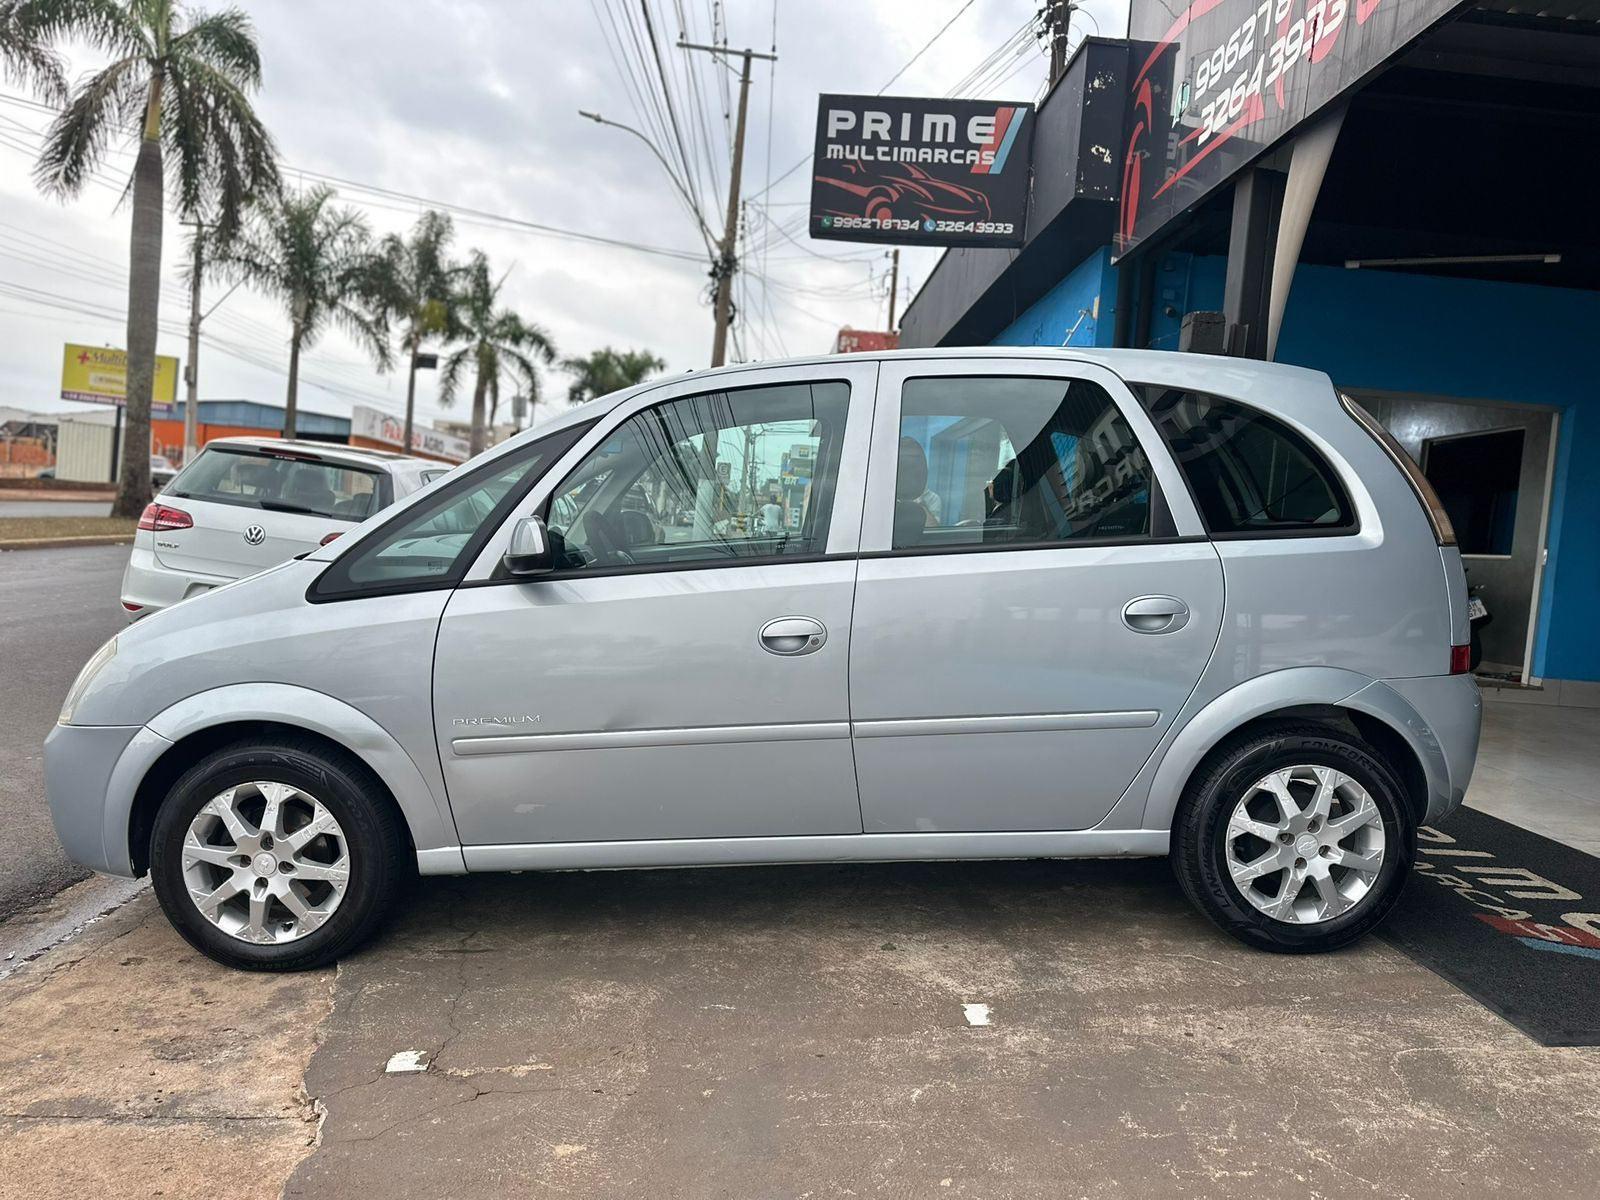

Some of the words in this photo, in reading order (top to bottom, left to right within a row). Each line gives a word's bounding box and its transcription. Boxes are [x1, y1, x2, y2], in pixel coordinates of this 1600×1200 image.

[827, 109, 996, 144] PRIME
[827, 144, 996, 165] MULTIMARCAS
[424, 434, 444, 453] AGRO
[451, 714, 543, 726] PREMIUM
